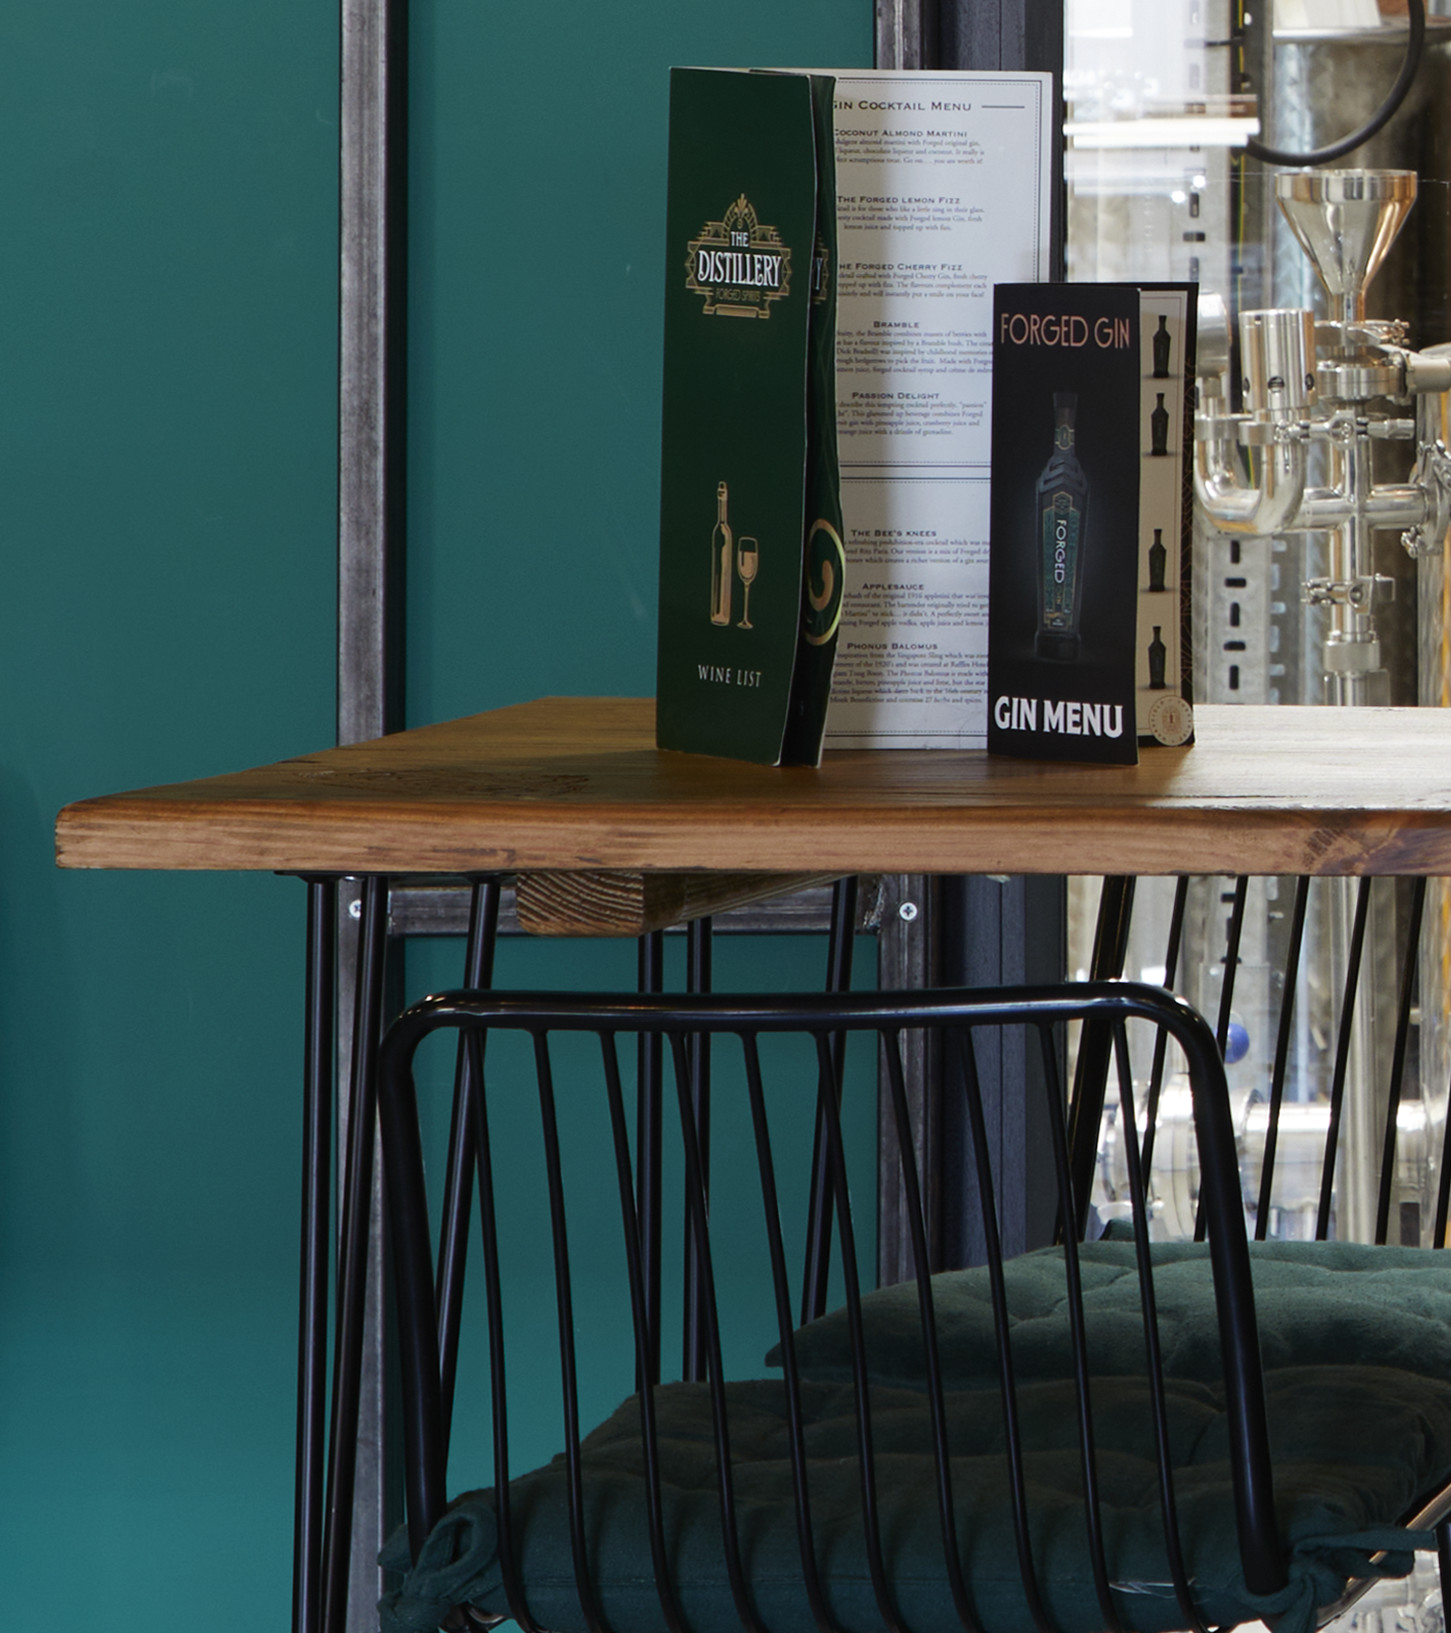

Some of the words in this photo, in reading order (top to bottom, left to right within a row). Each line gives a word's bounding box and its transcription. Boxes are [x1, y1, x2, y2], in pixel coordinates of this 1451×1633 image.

[858, 100, 925, 111] COCKTAIL
[930, 101, 972, 112] MENU
[881, 129, 924, 137] ALMOND
[859, 196, 899, 204] FORGED
[938, 197, 961, 205] FIZZ
[730, 231, 749, 247] THE
[697, 250, 783, 287] DISTILLERY
[855, 263, 894, 271] FORGED
[897, 263, 937, 271] CHERRY
[873, 321, 920, 329] BRAMBLE
[1001, 312, 1089, 347] FORGED
[1094, 317, 1130, 349] GIN
[851, 392, 894, 400] PASSION
[897, 392, 940, 400] DELIGHT
[1054, 519, 1067, 584] FORGED
[698, 664, 732, 685] WINE
[737, 669, 762, 688] LIST
[994, 695, 1038, 732] GIN
[1043, 700, 1123, 739] MENU
